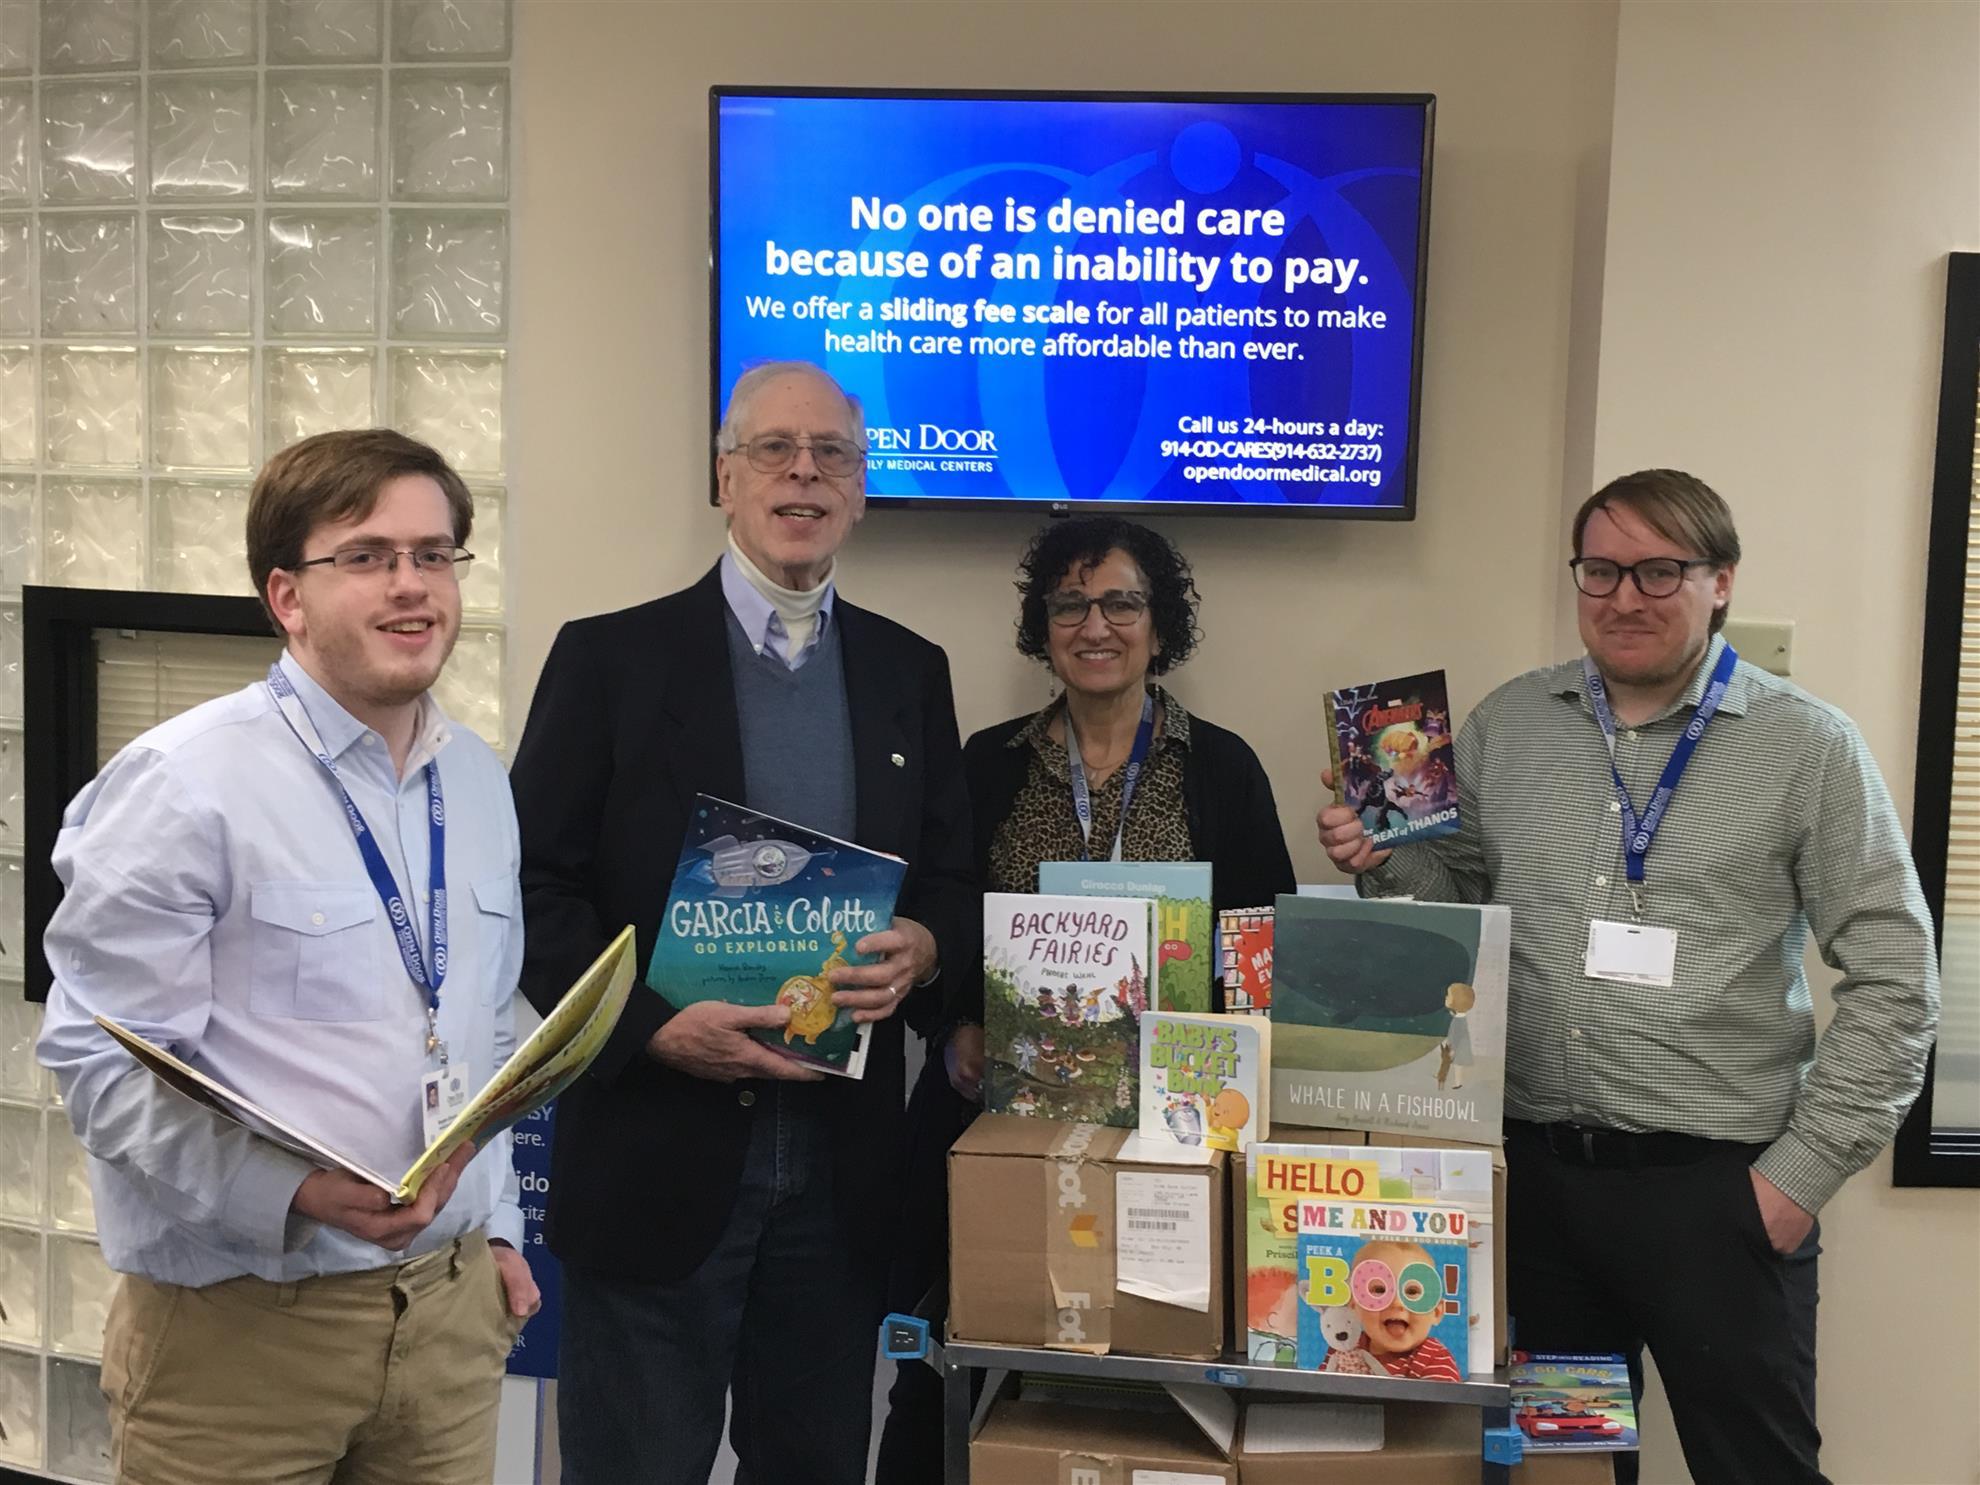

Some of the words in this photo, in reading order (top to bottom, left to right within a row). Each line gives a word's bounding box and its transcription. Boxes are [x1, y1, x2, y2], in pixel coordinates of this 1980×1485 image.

[851, 197, 906, 231] No
[918, 203, 993, 232] one
[1005, 198, 1036, 232] is
[1048, 198, 1185, 235] denied
[1197, 207, 1285, 235] care
[766, 241, 929, 278] because
[940, 244, 983, 279] of
[991, 251, 1040, 279] an
[1054, 245, 1220, 292] inability
[1230, 252, 1273, 284] to
[1285, 257, 1369, 293] pay.
[746, 296, 785, 319] We
[793, 296, 852, 320] offer
[858, 302, 873, 320] a
[880, 297, 968, 328] sliding
[973, 299, 1016, 323] fee
[1022, 300, 1090, 324] scale
[1096, 301, 1133, 325] for
[1139, 302, 1168, 325] all
[1176, 304, 1277, 331] patients
[1284, 307, 1310, 328] to
[1317, 305, 1387, 328] make
[825, 329, 902, 352] health
[909, 334, 962, 354] care
[970, 336, 1036, 355] more
[1042, 333, 1172, 358] affordable
[1179, 335, 1236, 359] than
[1243, 341, 1304, 360] ever.
[866, 428, 910, 449] PEN
[919, 424, 998, 451] DOOR
[1178, 416, 1213, 433] Call
[1217, 419, 1238, 434] us
[1243, 417, 1324, 436] 24-hours
[1329, 423, 1340, 436] a
[1345, 419, 1384, 440] day:
[867, 460, 883, 470] ILY
[887, 459, 937, 471] MEDICAL
[940, 461, 993, 472] CENTERS
[1183, 463, 1381, 486] opendoormedical.org
[1372, 827, 1399, 844] REAT
[1407, 807, 1458, 832] THANOS
[786, 896, 877, 934] Colette
[1010, 911, 1128, 941] BACKYARD
[695, 942, 717, 954] GO
[1029, 938, 1118, 966] FAIRIES
[1251, 947, 1272, 971] MA
[1289, 1083, 1345, 1109] WHALE
[1355, 1090, 1370, 1111] IN
[1378, 1093, 1390, 1113] A
[1397, 1094, 1479, 1122] FISHBOWL
[513, 1131, 545, 1147] ere.
[1267, 1160, 1364, 1196] HELLO
[1303, 1205, 1343, 1228] ME
[1351, 1208, 1407, 1232] AND
[1412, 1211, 1465, 1235] YOU
[1306, 1245, 1332, 1256] PEEK
[1335, 1247, 1343, 1256] A
[1305, 1256, 1460, 1316] BOO!
[1572, 1354, 1613, 1362] READING
